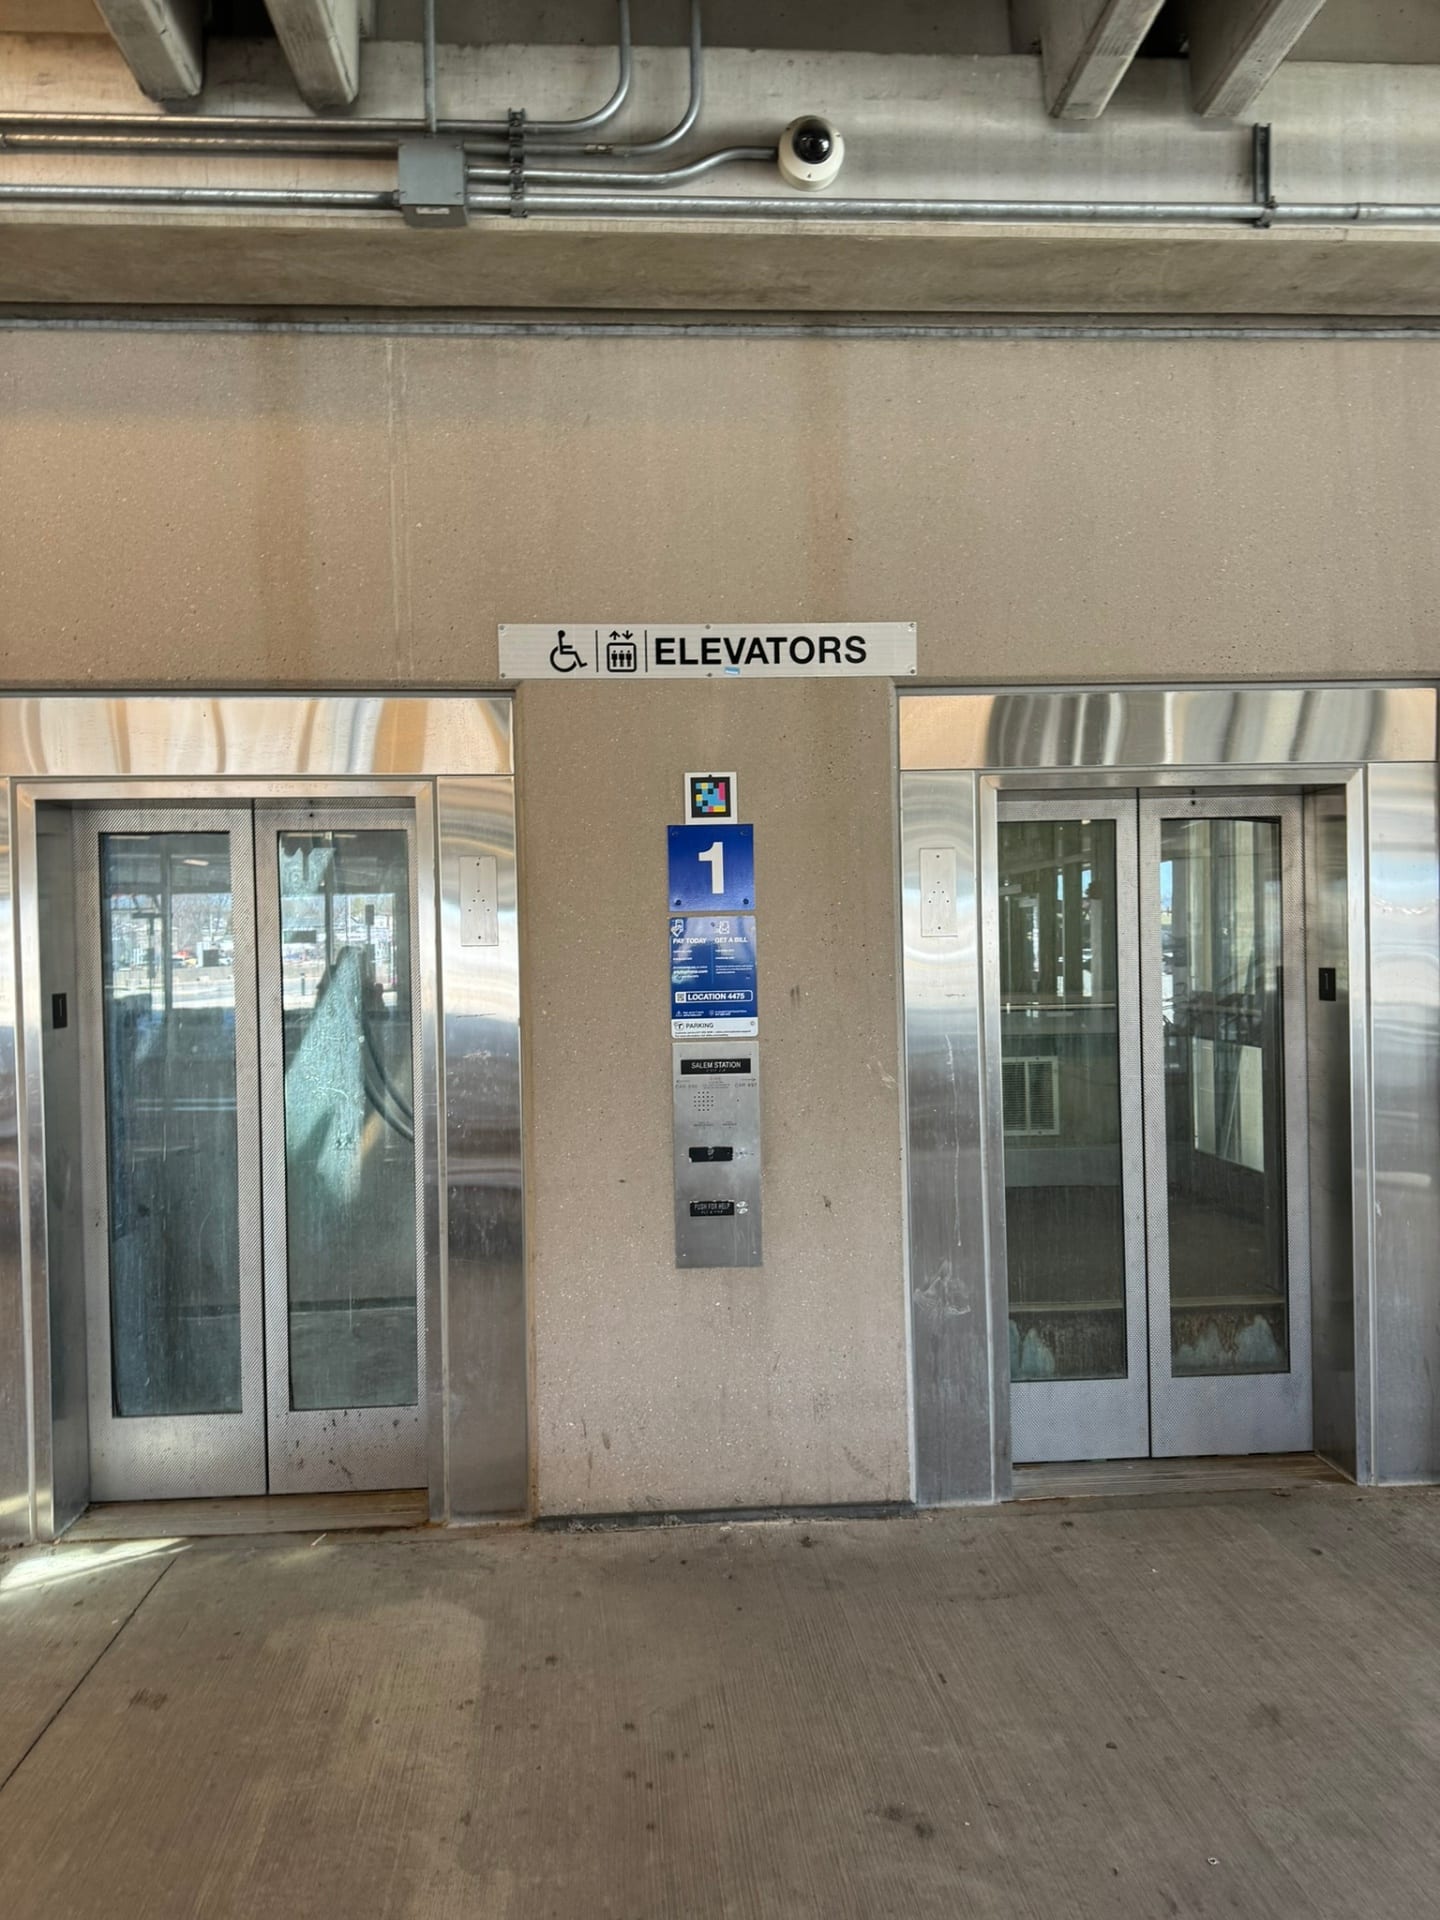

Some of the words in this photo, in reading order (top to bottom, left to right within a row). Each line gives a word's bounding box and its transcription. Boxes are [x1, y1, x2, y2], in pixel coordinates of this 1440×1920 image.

[655, 635, 867, 666] ELEVATORS
[698, 841, 725, 895] 1
[687, 993, 726, 1001] LOCATION
